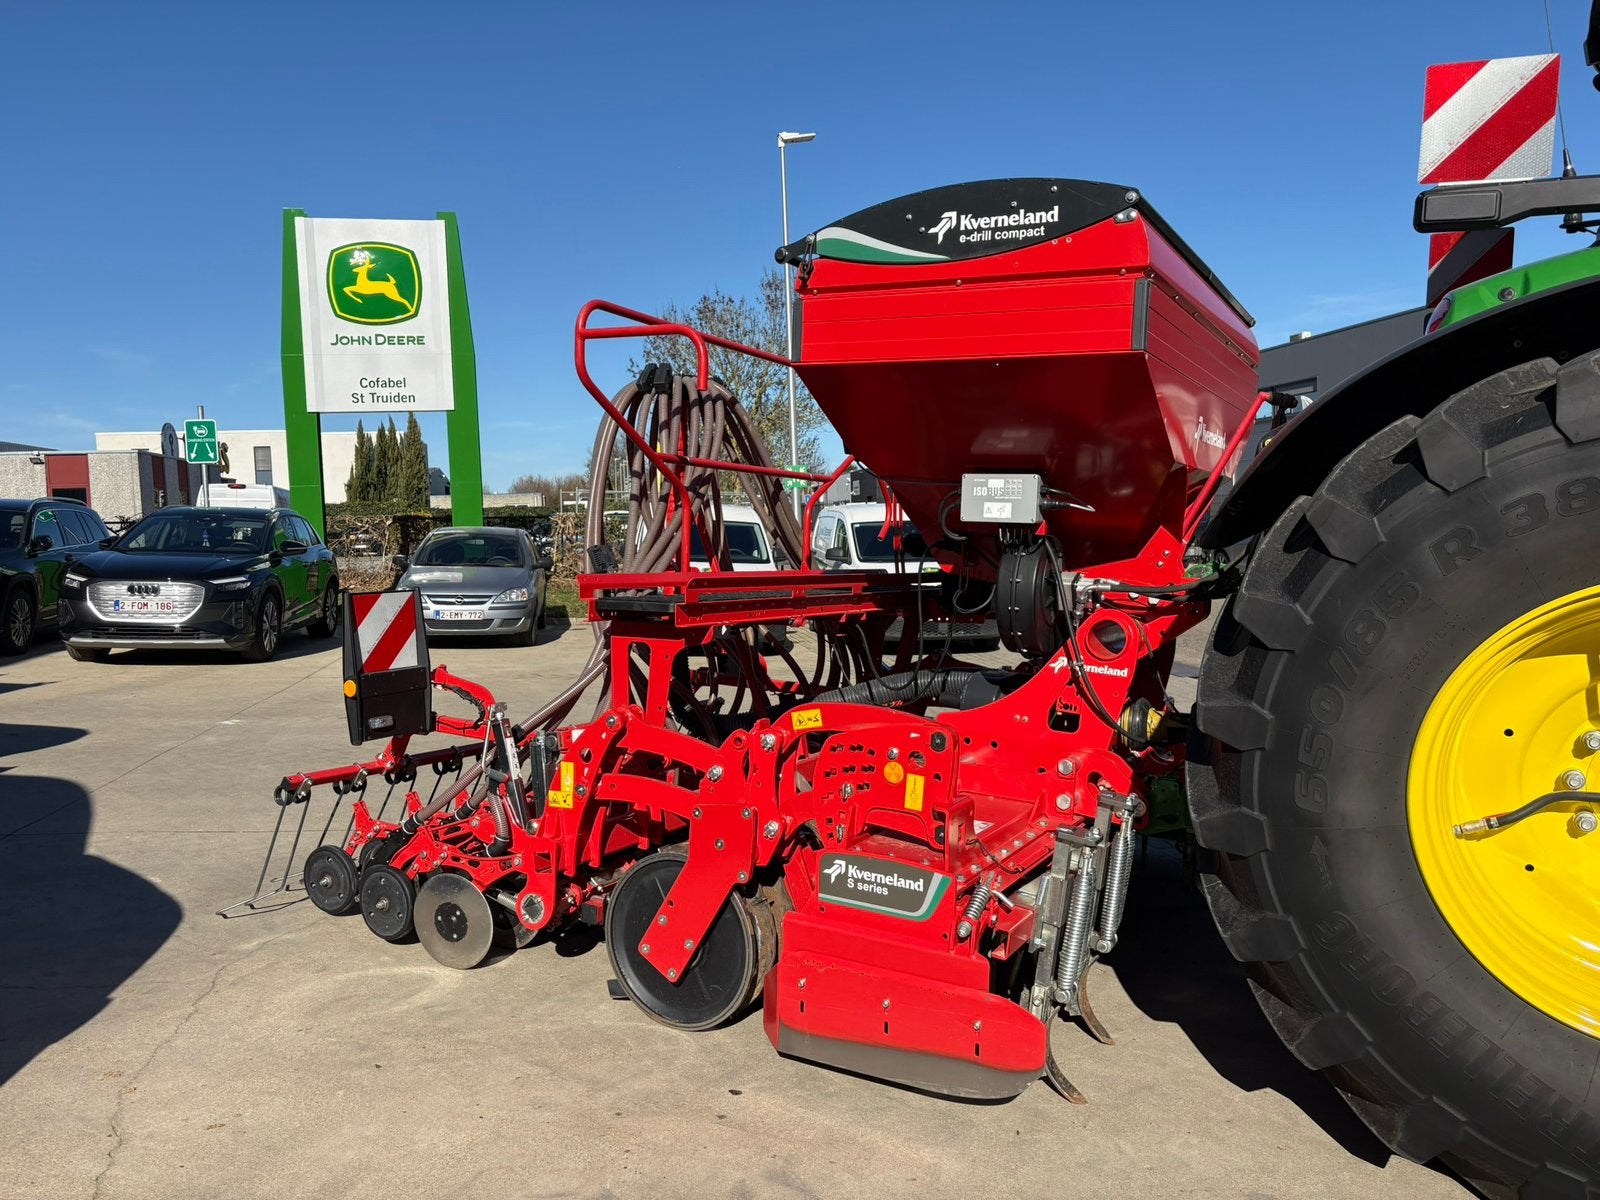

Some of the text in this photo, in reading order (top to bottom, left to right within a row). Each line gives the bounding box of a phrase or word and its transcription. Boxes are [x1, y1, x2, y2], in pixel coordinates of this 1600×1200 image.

[960, 205, 1059, 231] Kverneland
[959, 225, 1045, 243] e-drill compact
[330, 334, 425, 346] JOHN DEERE
[359, 377, 406, 389] Cofabel
[351, 392, 416, 403] St Truiden
[1294, 568, 1423, 815] 650/85
[1500, 475, 1600, 538] 38
[846, 878, 889, 896] S series
[848, 864, 924, 893] Kverneland
